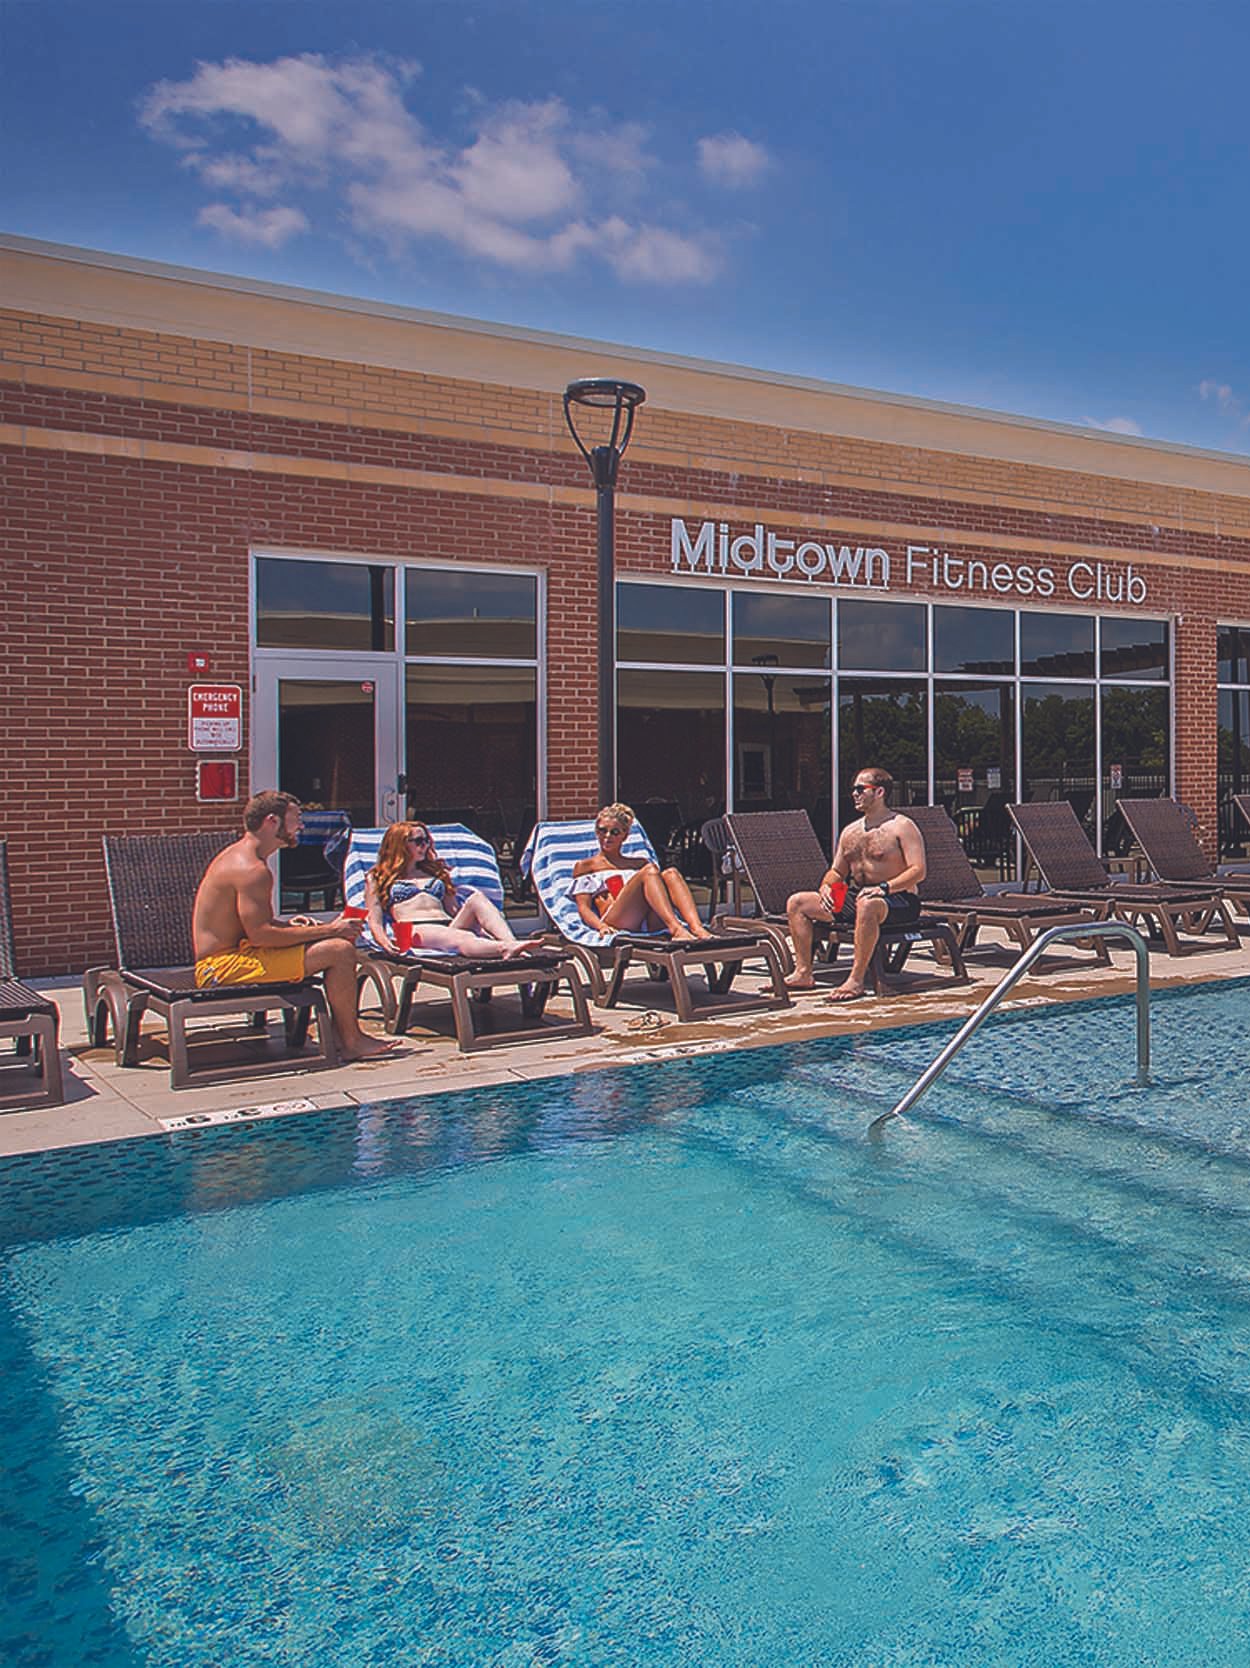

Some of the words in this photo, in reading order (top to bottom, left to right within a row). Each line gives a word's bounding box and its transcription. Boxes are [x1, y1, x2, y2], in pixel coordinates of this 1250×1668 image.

[671, 518, 891, 580] Midtown
[906, 545, 1055, 596] Fitness
[1068, 562, 1147, 604] Club
[192, 692, 238, 702] EMERGENCY
[202, 703, 229, 713] PHONE
